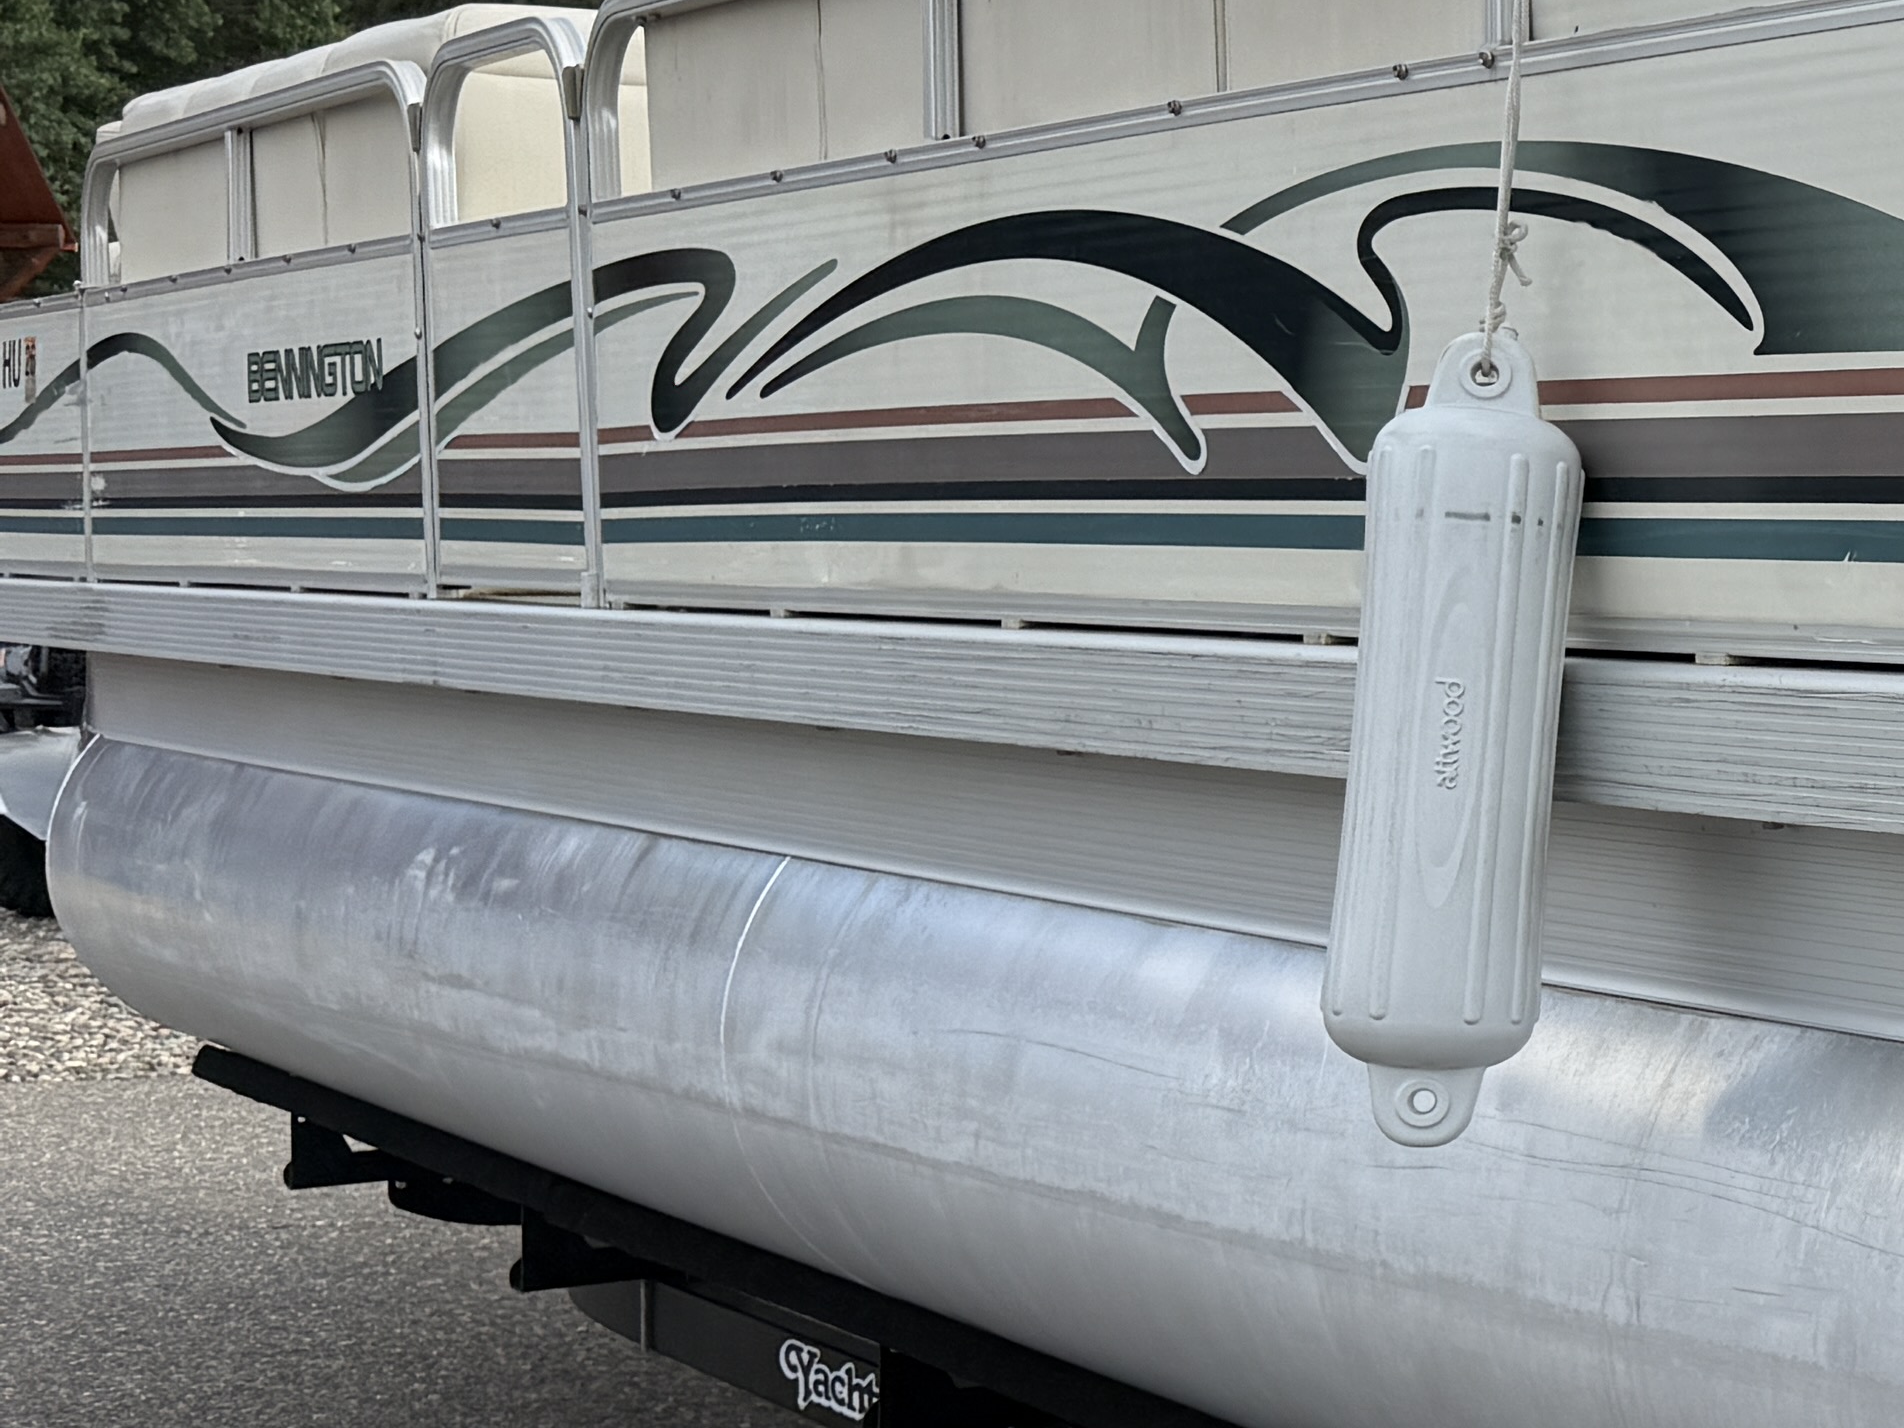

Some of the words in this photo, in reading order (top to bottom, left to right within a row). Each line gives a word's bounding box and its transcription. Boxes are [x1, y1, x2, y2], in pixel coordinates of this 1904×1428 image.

[3, 338, 21, 389] HU
[248, 338, 383, 403] BENNINGTON
[1434, 677, 1466, 790] attwood
